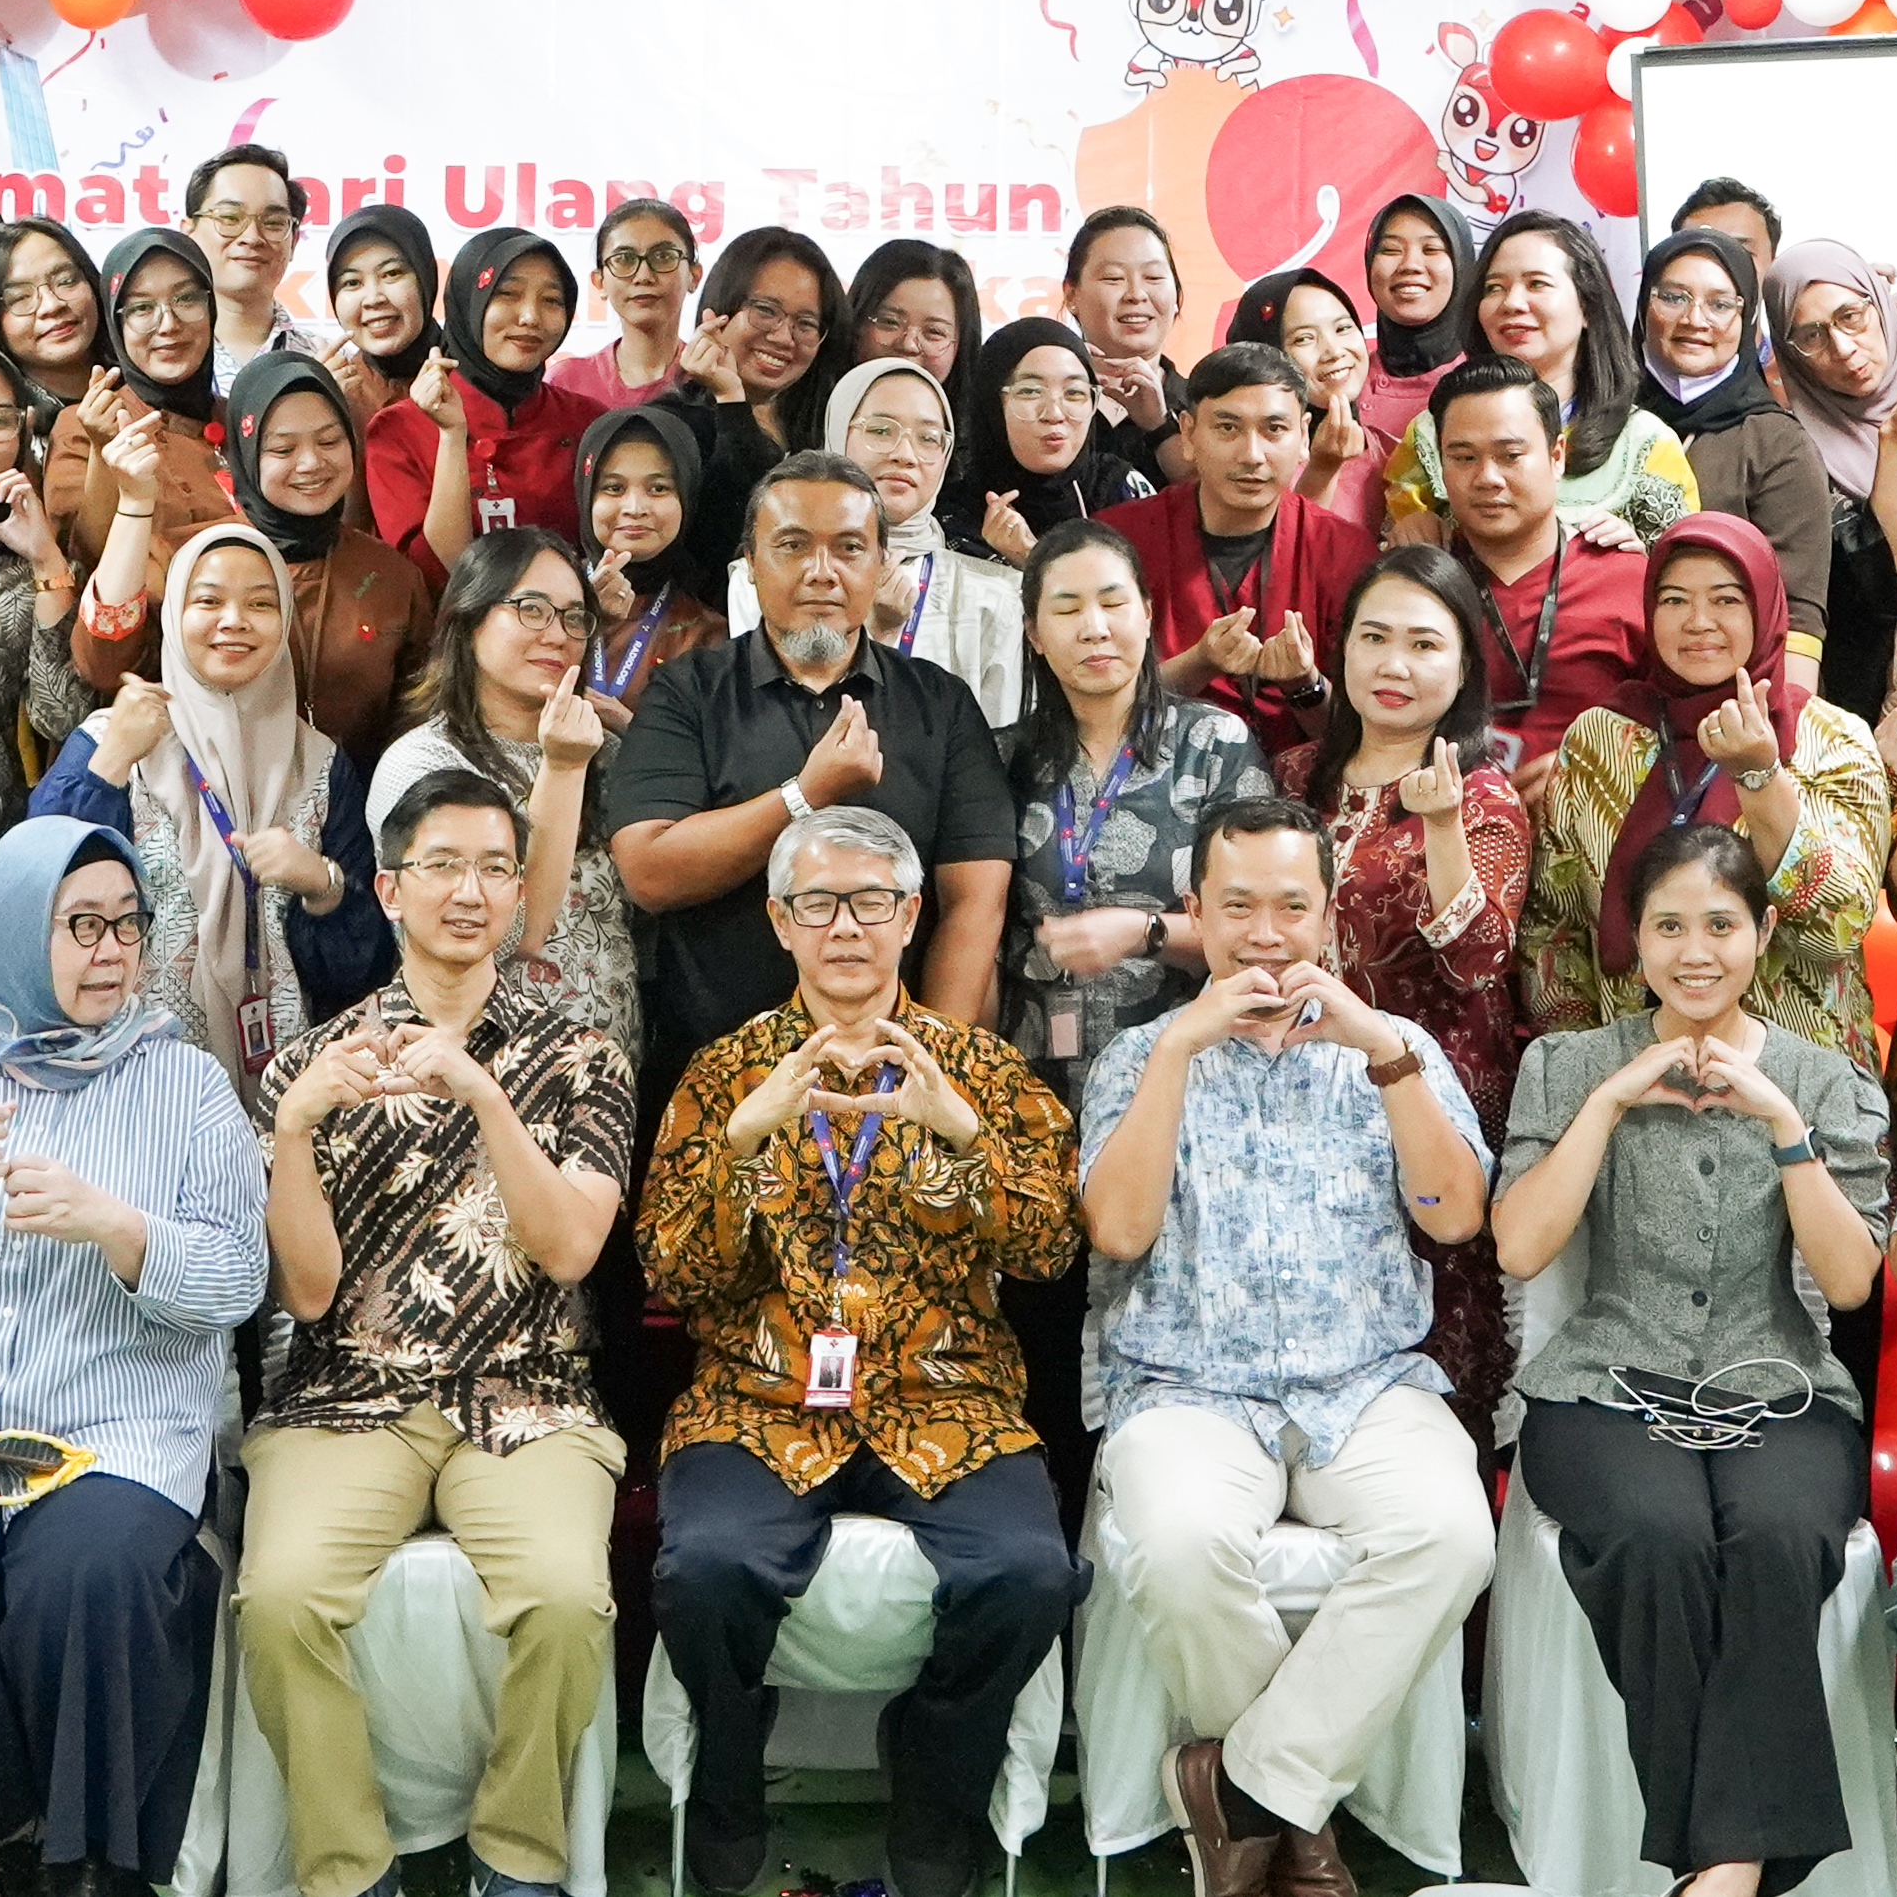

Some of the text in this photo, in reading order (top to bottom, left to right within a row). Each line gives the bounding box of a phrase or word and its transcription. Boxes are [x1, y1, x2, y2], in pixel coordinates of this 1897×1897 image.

[300, 155, 406, 227] ari
[443, 161, 726, 245] Ulang
[761, 165, 1062, 234] Tahun
[615, 640, 644, 686] RADIOLOGI
